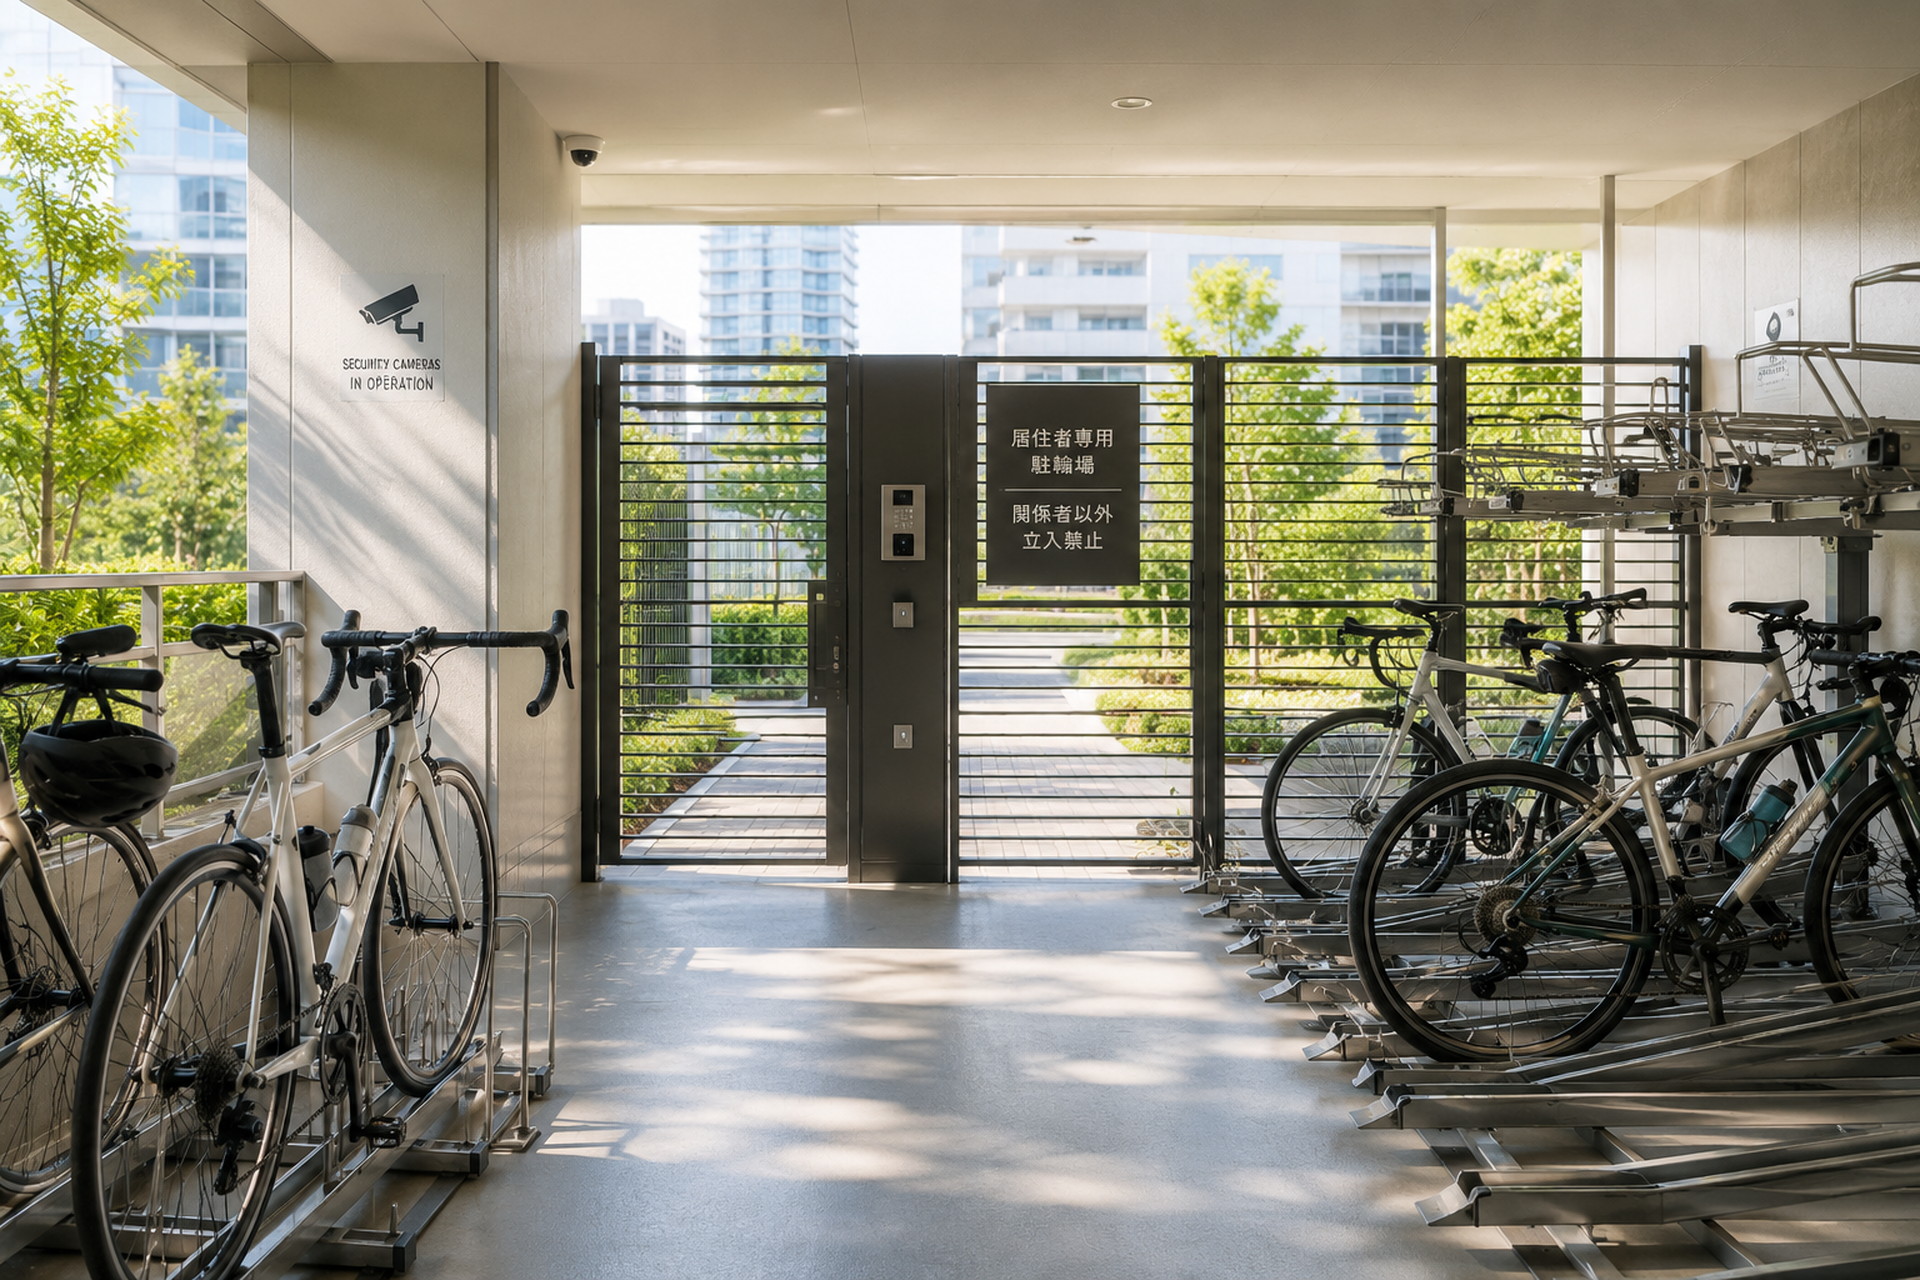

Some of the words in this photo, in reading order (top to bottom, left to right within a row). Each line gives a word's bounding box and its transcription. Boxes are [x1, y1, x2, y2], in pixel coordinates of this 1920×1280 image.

[393, 358, 441, 370] CAMERAS
[350, 376, 362, 390] IN
[367, 375, 434, 391] OPERATION
[1011, 428, 1113, 448] 居住者専用
[1013, 504, 1113, 524] 関係者以外
[1022, 531, 1103, 550] 立入禁止
